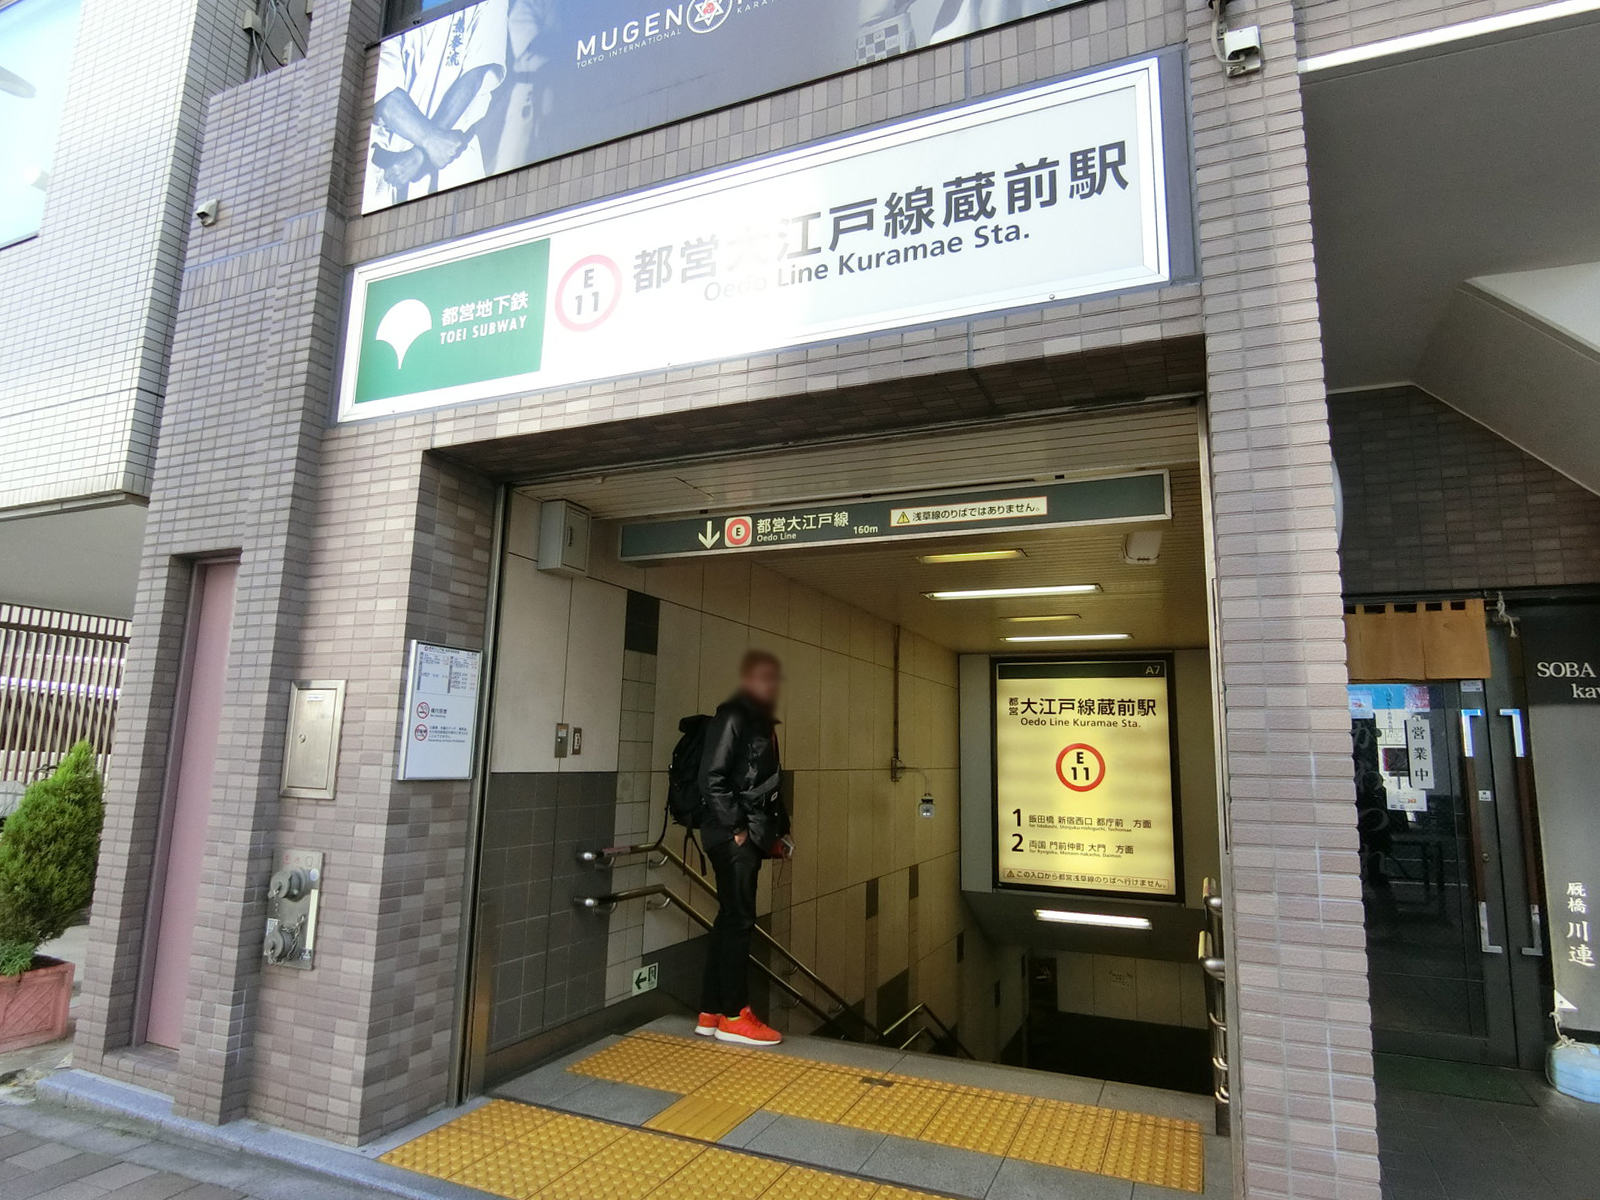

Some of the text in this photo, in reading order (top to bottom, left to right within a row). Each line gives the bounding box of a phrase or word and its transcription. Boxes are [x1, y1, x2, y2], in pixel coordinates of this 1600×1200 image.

[737, 0, 774, 14] KARA
[576, 4, 683, 60] MUGEN
[577, 28, 682, 69] TOKYO INTERNATIONAL
[633, 139, 1130, 294] 都営大江戸線蔵前駅
[704, 221, 1030, 301] Oedo Line Kuramae Sta.
[583, 268, 595, 289] E
[441, 291, 529, 326] 都営地下鉄
[575, 291, 600, 316] 11
[440, 315, 527, 345] TOEI SUBWAY
[756, 511, 849, 534] 都営大江戸線
[912, 502, 1040, 522] 浅草線のりばではありません。
[735, 527, 741, 537] E
[756, 532, 797, 543] Oedo Line
[853, 525, 878, 535] 160m
[1145, 665, 1160, 675] A7
[1536, 661, 1597, 678] SOBA
[1020, 698, 1157, 716] 大江戸線蔵前駅
[1020, 717, 1141, 728] Oedo Line Kuramae Sta.
[1076, 751, 1084, 764] E
[1411, 726, 1429, 782] 営業中
[1071, 767, 1090, 781] 11
[1012, 808, 1151, 829] 1 飯田橋 新宿西口 都庁前 方面
[1011, 833, 1134, 854] 2 両国 門前仲町 大門 方面
[1566, 920, 1596, 967] 川連
